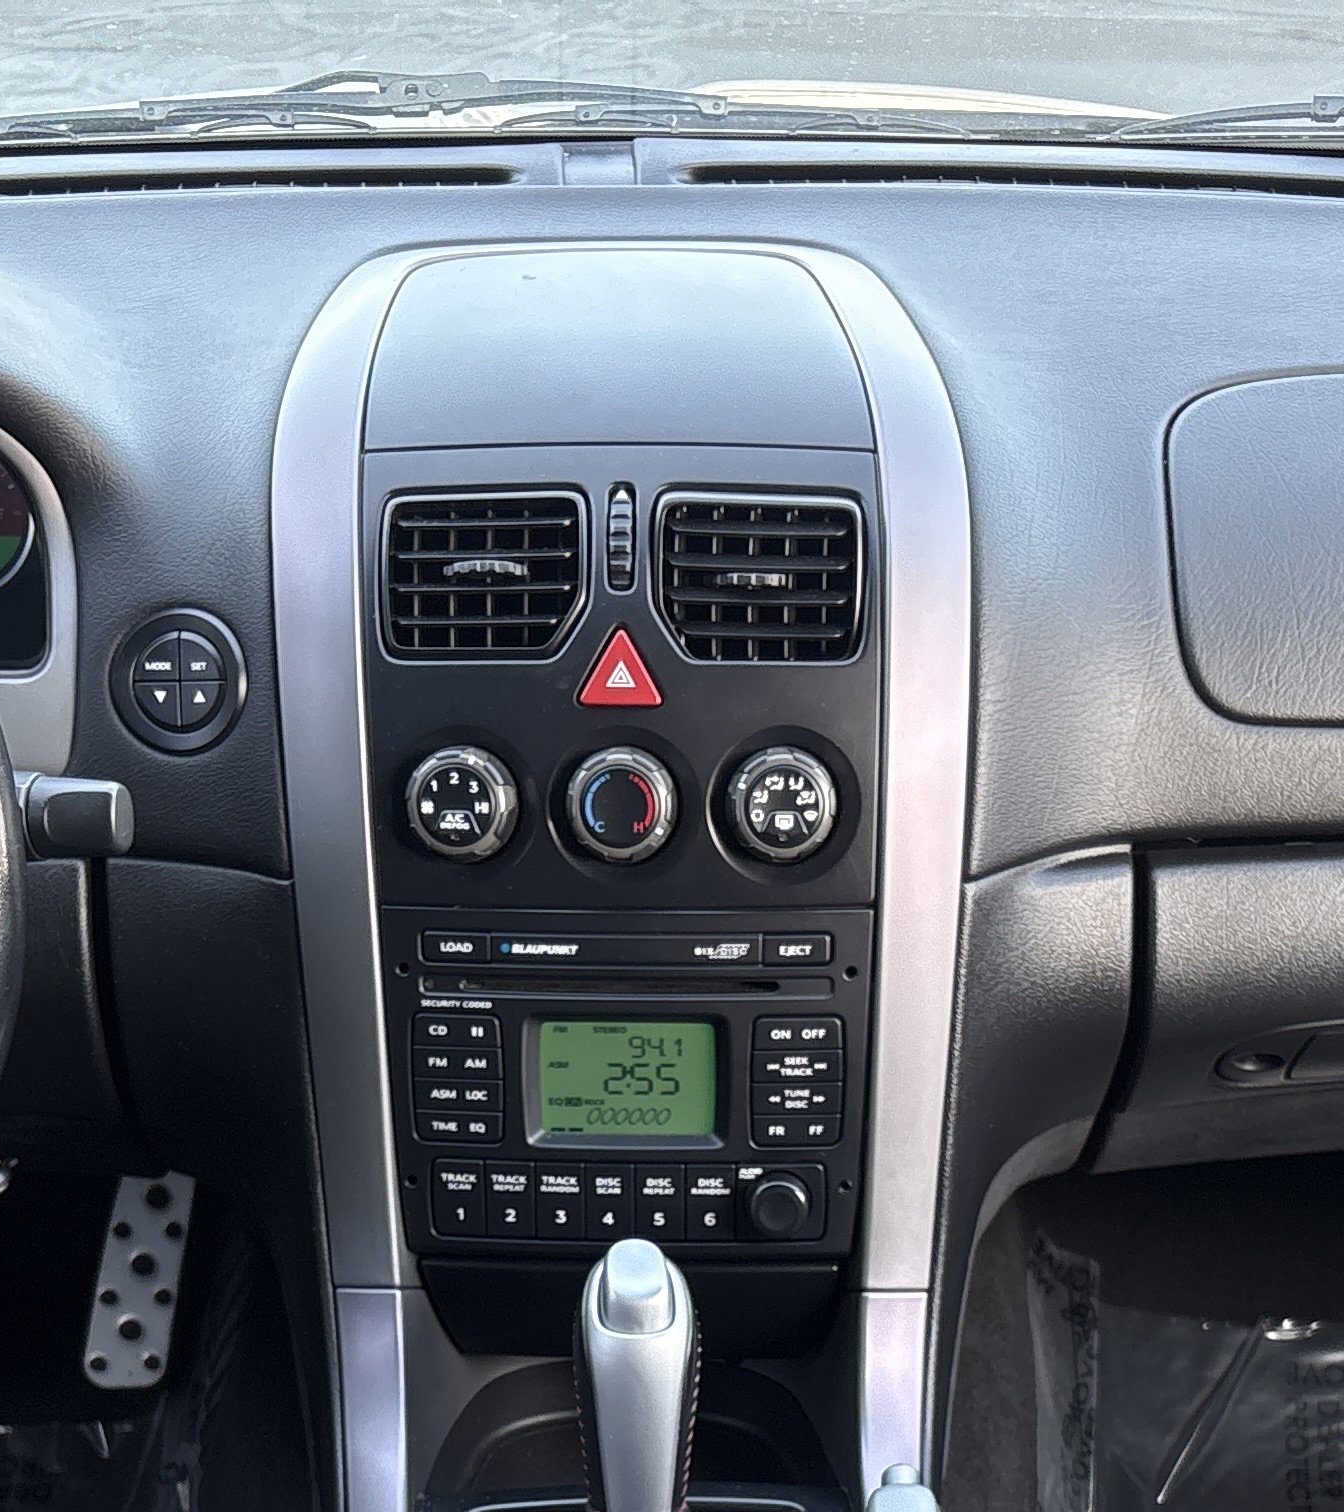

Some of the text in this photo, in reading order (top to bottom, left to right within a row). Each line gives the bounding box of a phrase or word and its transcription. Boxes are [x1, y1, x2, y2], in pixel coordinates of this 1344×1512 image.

[449, 771, 459, 785] 2
[430, 779, 438, 792] 1
[468, 780, 479, 793] 3
[474, 801, 490, 814] HI
[593, 820, 606, 834] C
[632, 821, 645, 834] H
[439, 941, 474, 953] LOAD
[779, 944, 814, 957] EJECT
[428, 1024, 448, 1036] CD
[770, 1029, 792, 1040] ON
[801, 1028, 827, 1040] OFF
[427, 1056, 448, 1068] FM
[463, 1057, 487, 1069] AM
[603, 1062, 680, 1096] 2:55
[430, 1088, 457, 1100] ASM
[465, 1089, 489, 1101] LOC
[431, 1120, 458, 1132] TIME
[468, 1122, 486, 1134] EQ
[768, 1125, 785, 1136] FR
[808, 1125, 825, 1136] FF
[440, 1172, 477, 1183] TRACK
[490, 1174, 527, 1184] TRACK
[541, 1175, 578, 1186] TRACK
[595, 1177, 622, 1187] DISC
[646, 1177, 672, 1187] DISC
[697, 1177, 724, 1187] DISC
[456, 1207, 466, 1221] 1
[504, 1208, 517, 1223] 2
[555, 1209, 568, 1224] 3
[601, 1211, 615, 1226] 4
[652, 1211, 666, 1227] 5
[703, 1211, 717, 1227] 6
